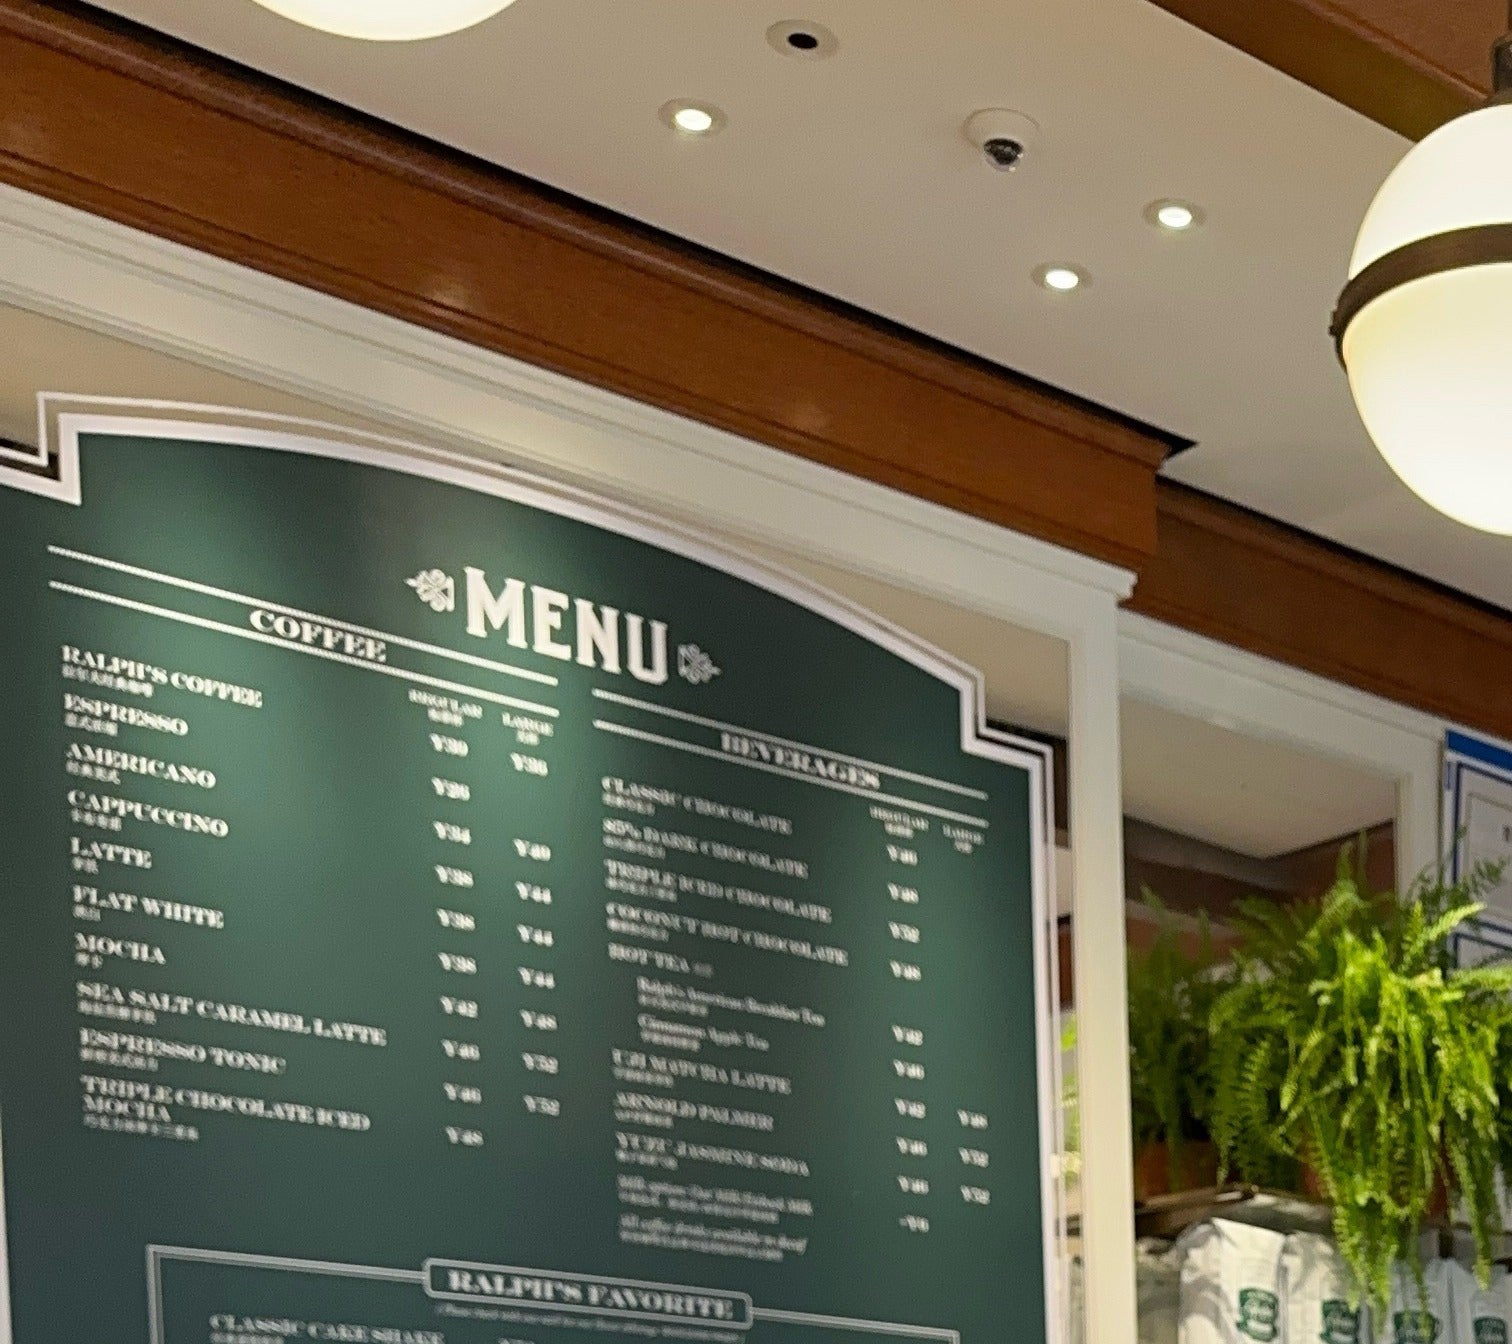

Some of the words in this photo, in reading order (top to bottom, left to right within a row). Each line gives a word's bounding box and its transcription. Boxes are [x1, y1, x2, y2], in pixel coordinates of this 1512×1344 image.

[249, 608, 387, 663] COFFEE
[463, 566, 669, 686] MENU
[61, 644, 169, 686] RALPH'S
[170, 671, 263, 709] COFFEE
[63, 692, 189, 736] ESPRESSO
[66, 743, 217, 789] AMERICANO
[721, 731, 881, 791] BEVERAGES
[67, 789, 229, 838] CAPPUCCINO
[70, 836, 152, 869] LATTE
[72, 884, 138, 913] FLAT
[141, 896, 224, 929] WHITE
[74, 932, 166, 965] MOCHA
[607, 941, 653, 966] HOT
[651, 949, 690, 974] TEA
[75, 981, 125, 1006] SEA
[128, 989, 194, 1016] SALT
[195, 1000, 312, 1034] CARAMEL
[312, 1016, 387, 1047] LATTE
[79, 1026, 207, 1063] ESPRESSO
[208, 1046, 287, 1075] TONIC
[80, 1073, 173, 1105] TRIPLE
[174, 1088, 315, 1124] CHOCOLATE
[730, 1068, 792, 1095] LATTE
[82, 1094, 172, 1123] MOCHA
[449, 1269, 583, 1302] RALPH'S
[586, 1283, 734, 1320] FAVORITE
